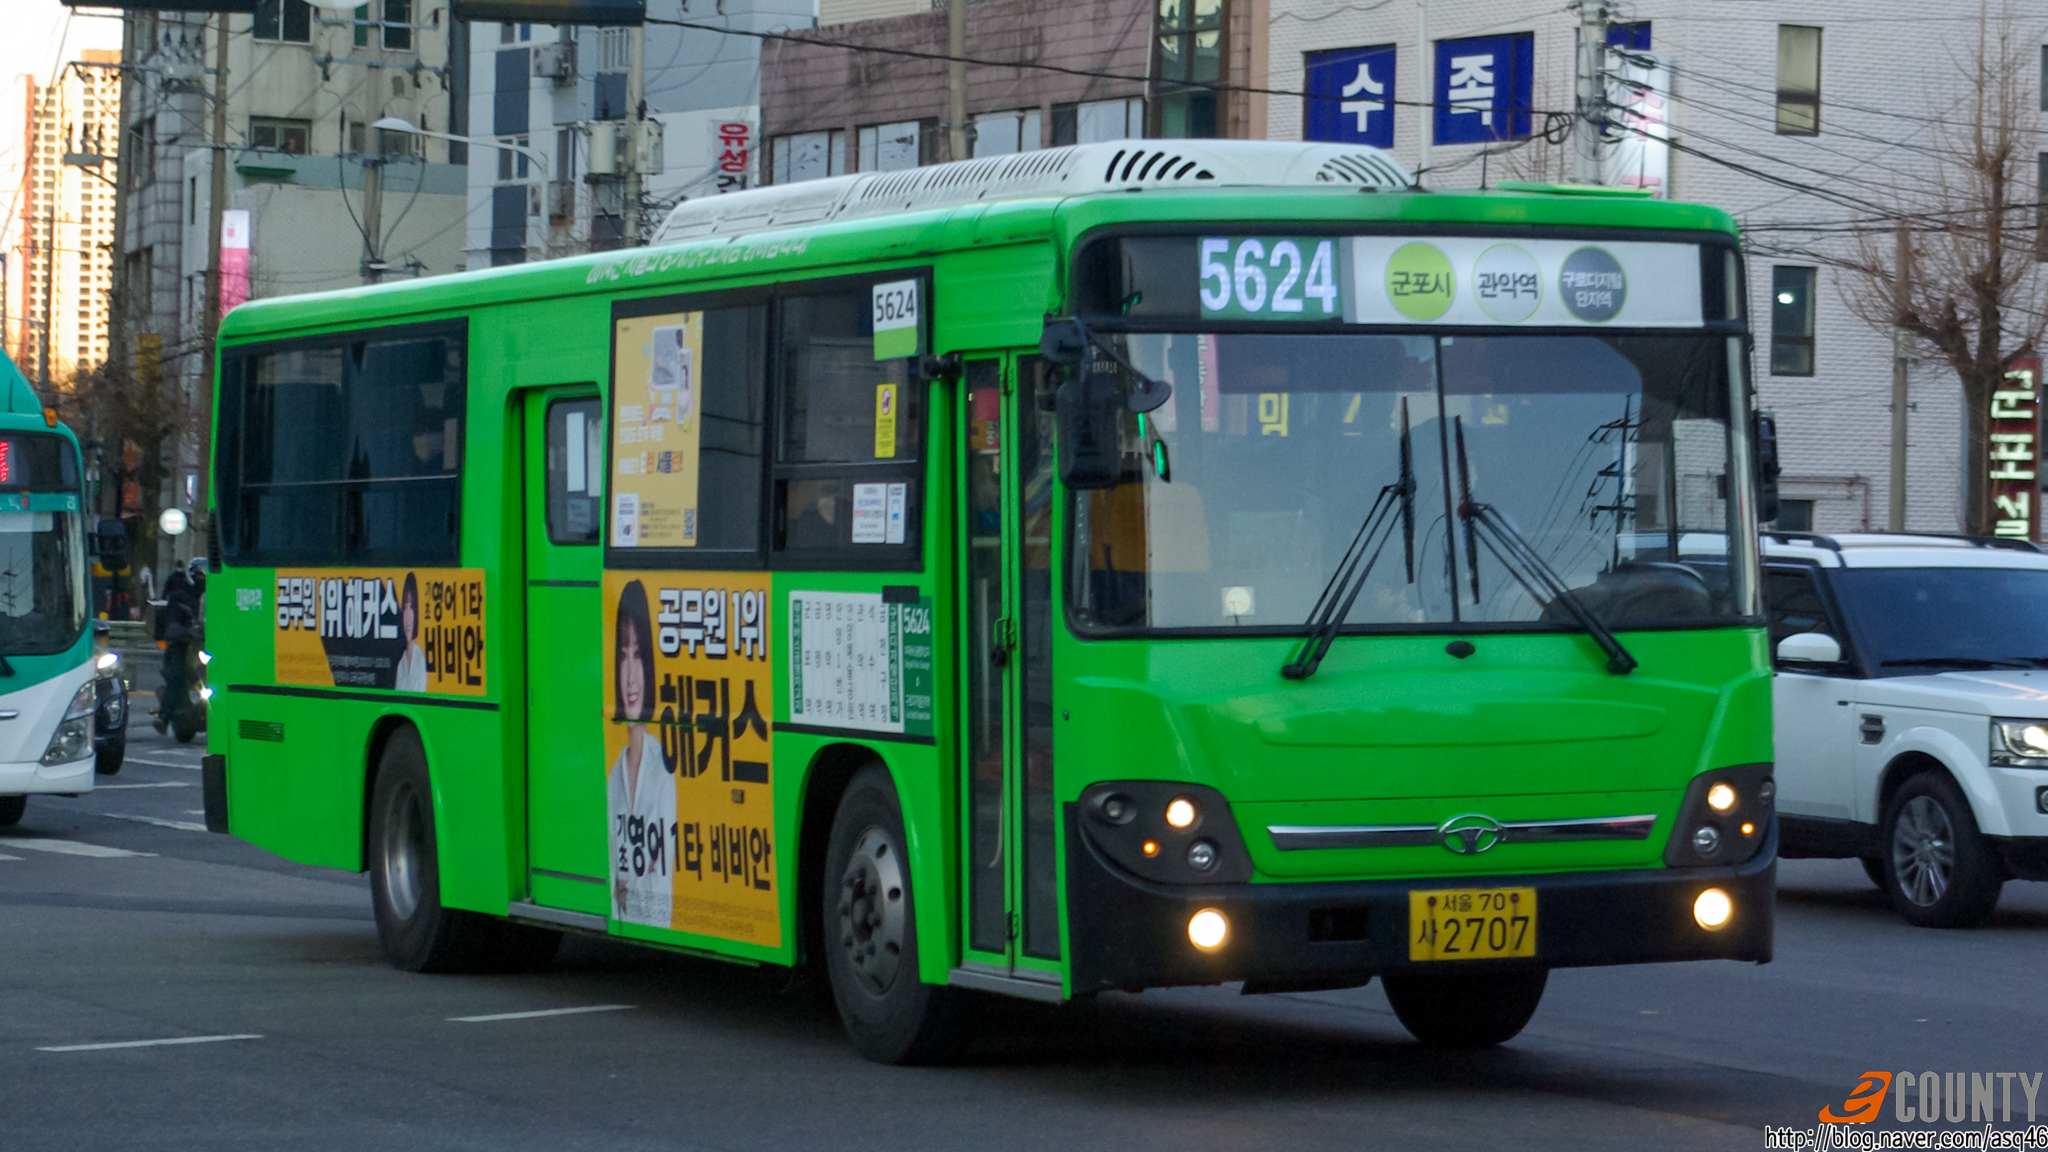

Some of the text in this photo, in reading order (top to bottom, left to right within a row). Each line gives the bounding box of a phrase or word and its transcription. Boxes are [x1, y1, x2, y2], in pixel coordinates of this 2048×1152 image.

[1199, 237, 1338, 314] 5624
[1390, 270, 1452, 300] 군포시
[1478, 272, 1538, 300] 관악역
[1561, 270, 1623, 290] 구로디지털
[876, 287, 915, 323] 5624
[1574, 290, 1613, 309] 단지역
[277, 577, 399, 639] 공무원 1위 해커스
[431, 581, 456, 622] 영어
[460, 581, 482, 620] 1타
[658, 587, 728, 660] 공무원
[732, 588, 766, 661] 1위
[903, 607, 931, 635] 5624
[425, 625, 483, 686] 비비안
[660, 673, 769, 784] 해커스
[628, 815, 666, 877] 영어
[670, 822, 703, 882] 1타
[710, 823, 772, 891] 비비안
[1442, 892, 1506, 913] 서울 70
